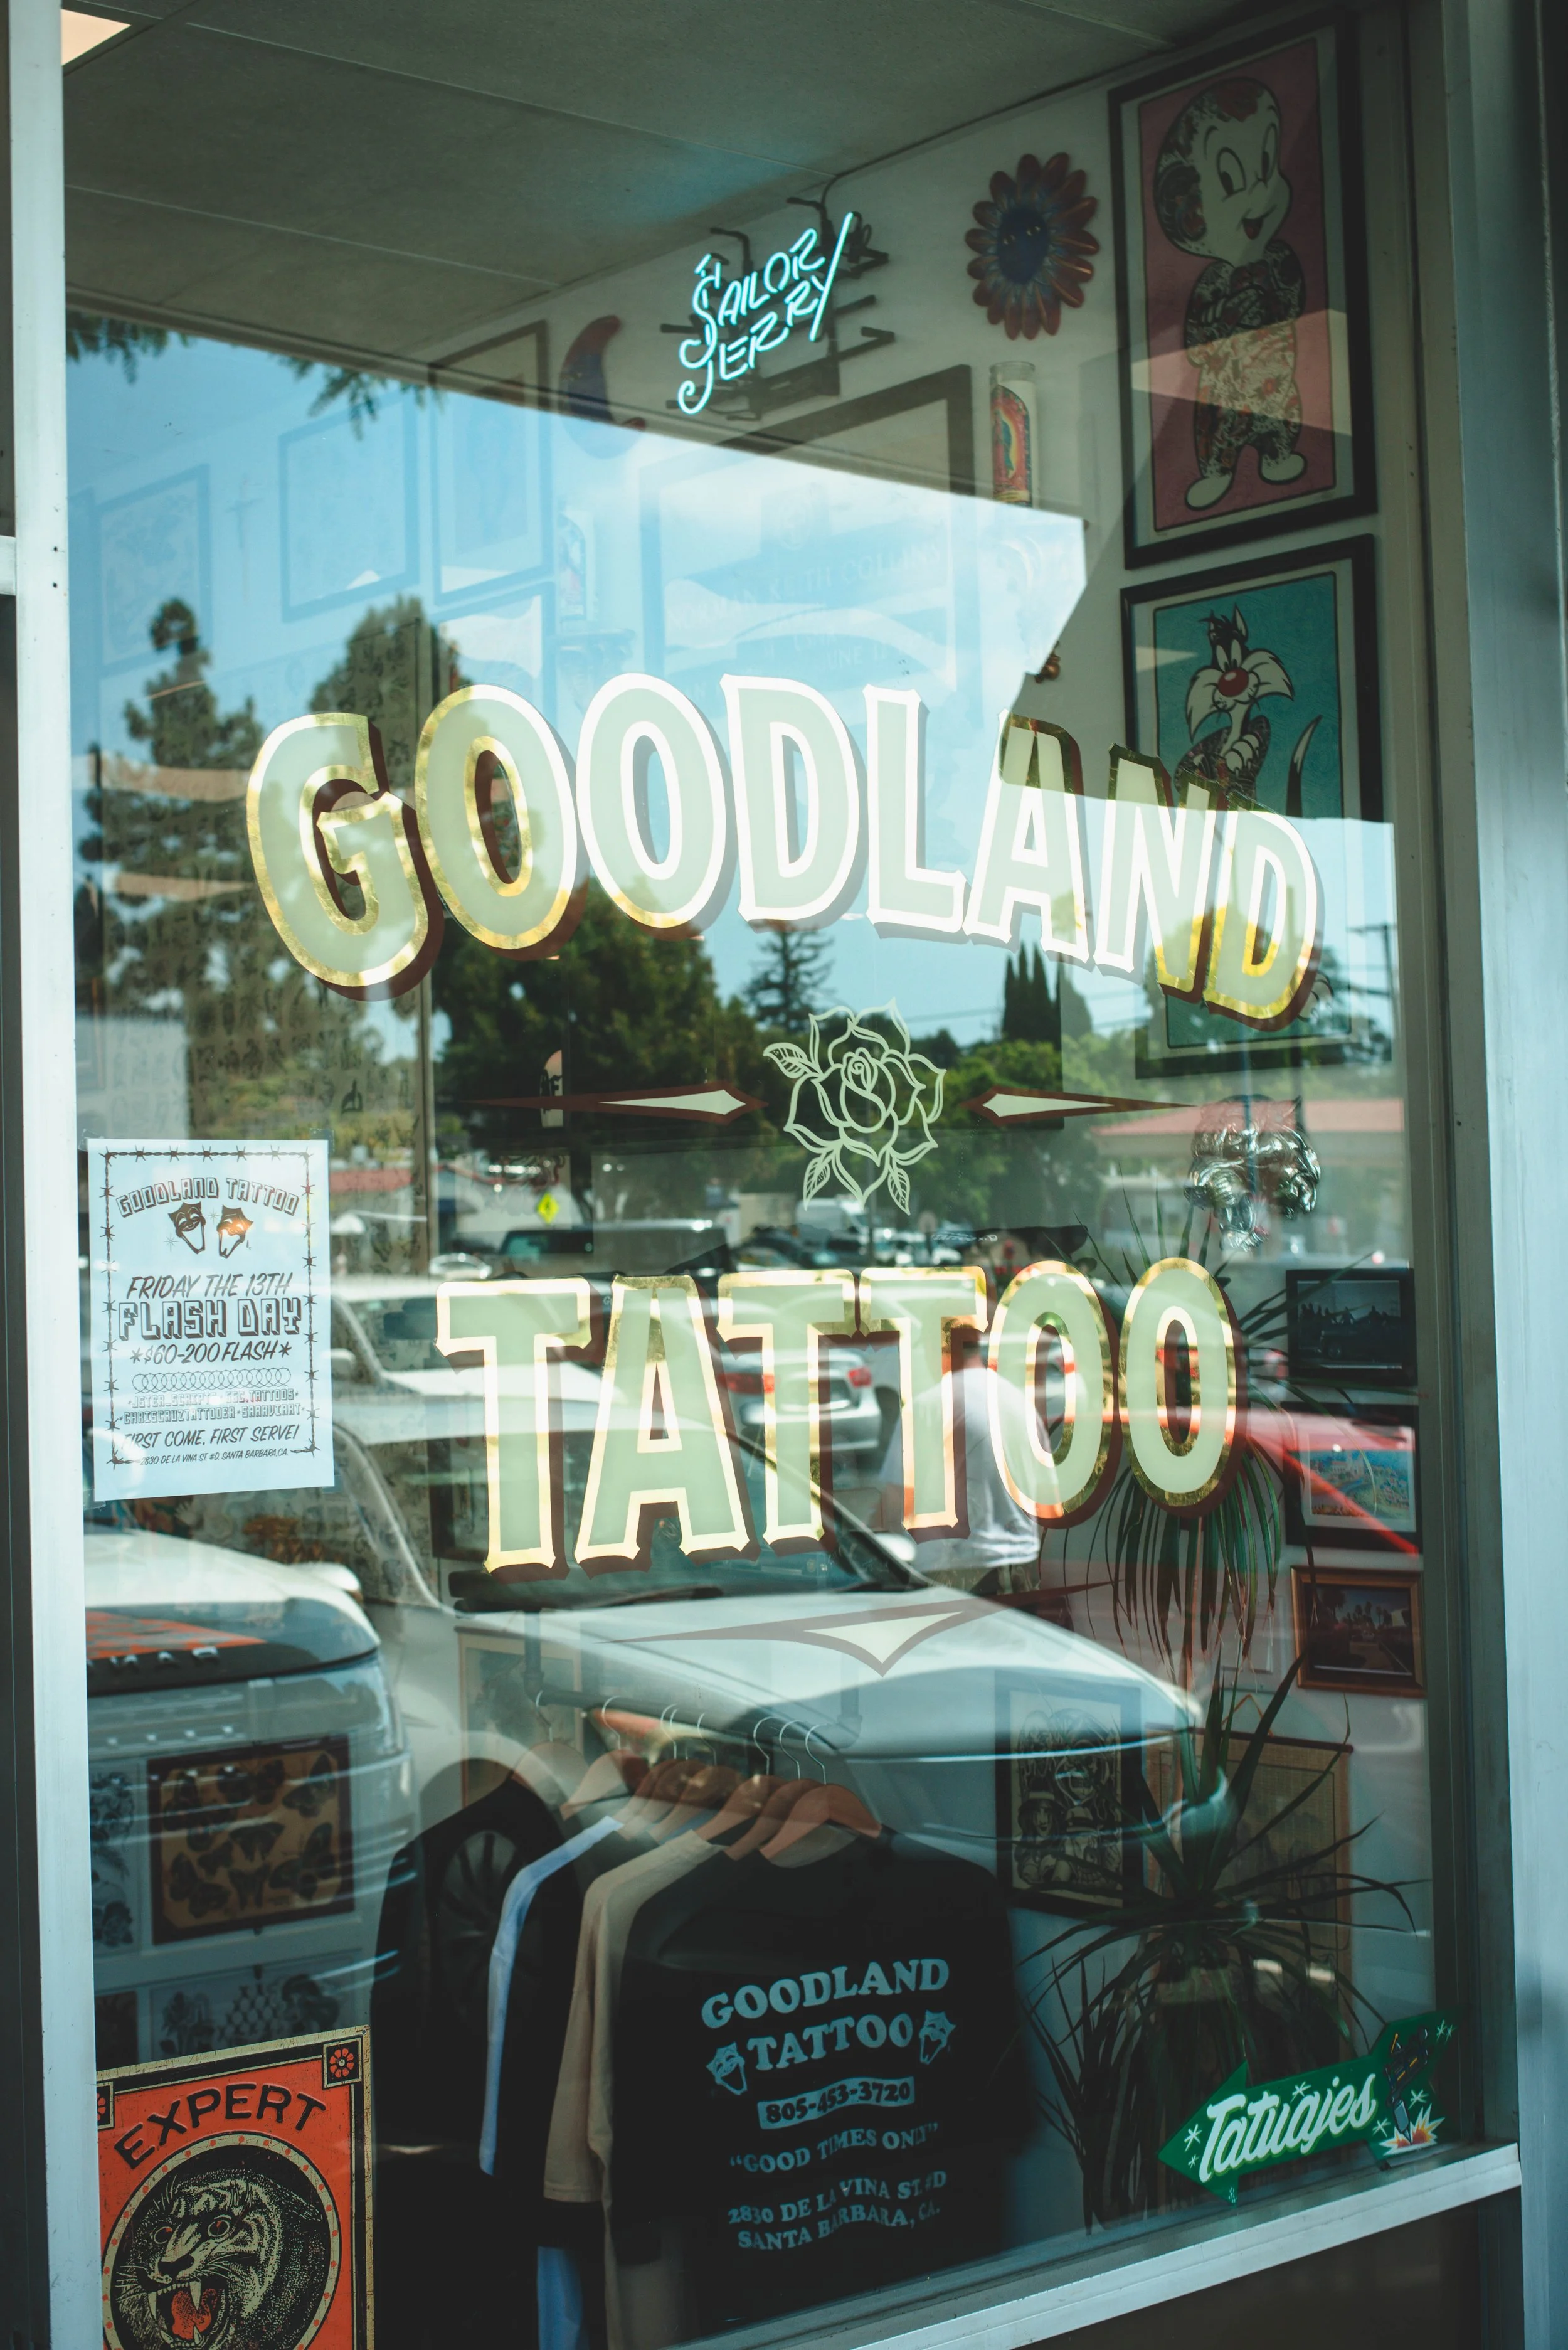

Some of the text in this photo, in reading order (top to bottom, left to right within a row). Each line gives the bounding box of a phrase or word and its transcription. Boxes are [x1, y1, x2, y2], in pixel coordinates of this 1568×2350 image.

[677, 211, 854, 415] JERRY
[679, 226, 826, 369] SAILOR
[246, 673, 1321, 1026] GOODLAND
[116, 1177, 300, 1218] GOODLAND TATTOO
[126, 1272, 294, 1299] FRIDAY THE 13TH
[119, 1297, 301, 1341] FLASH DAY
[221, 1339, 279, 1362] FLASH
[164, 1430, 206, 1447] COME,
[209, 1427, 249, 1445] FIRST
[250, 1423, 300, 1442] SERVE!
[434, 1257, 1241, 1578] TATTOO
[140, 1455, 159, 1465] 2830
[161, 1455, 170, 1464] DE
[171, 1454, 181, 1463] LA
[182, 1453, 198, 1462] VINA
[221, 1450, 243, 1460] SANTA
[701, 1957, 950, 2029] GOODLAND
[746, 2012, 914, 2071] TATTOO
[765, 2080, 911, 2124] 805-453-3720
[113, 2083, 326, 2170] EXPERT
[817, 2128, 877, 2160] TIMES
[1198, 2072, 1377, 2183] Tatuajes
[728, 2204, 774, 2225] 2830
[780, 2198, 812, 2222] DE
[817, 2188, 837, 2212] LA
[839, 2177, 891, 2200] VINA
[737, 2226, 813, 2250] SANTA
